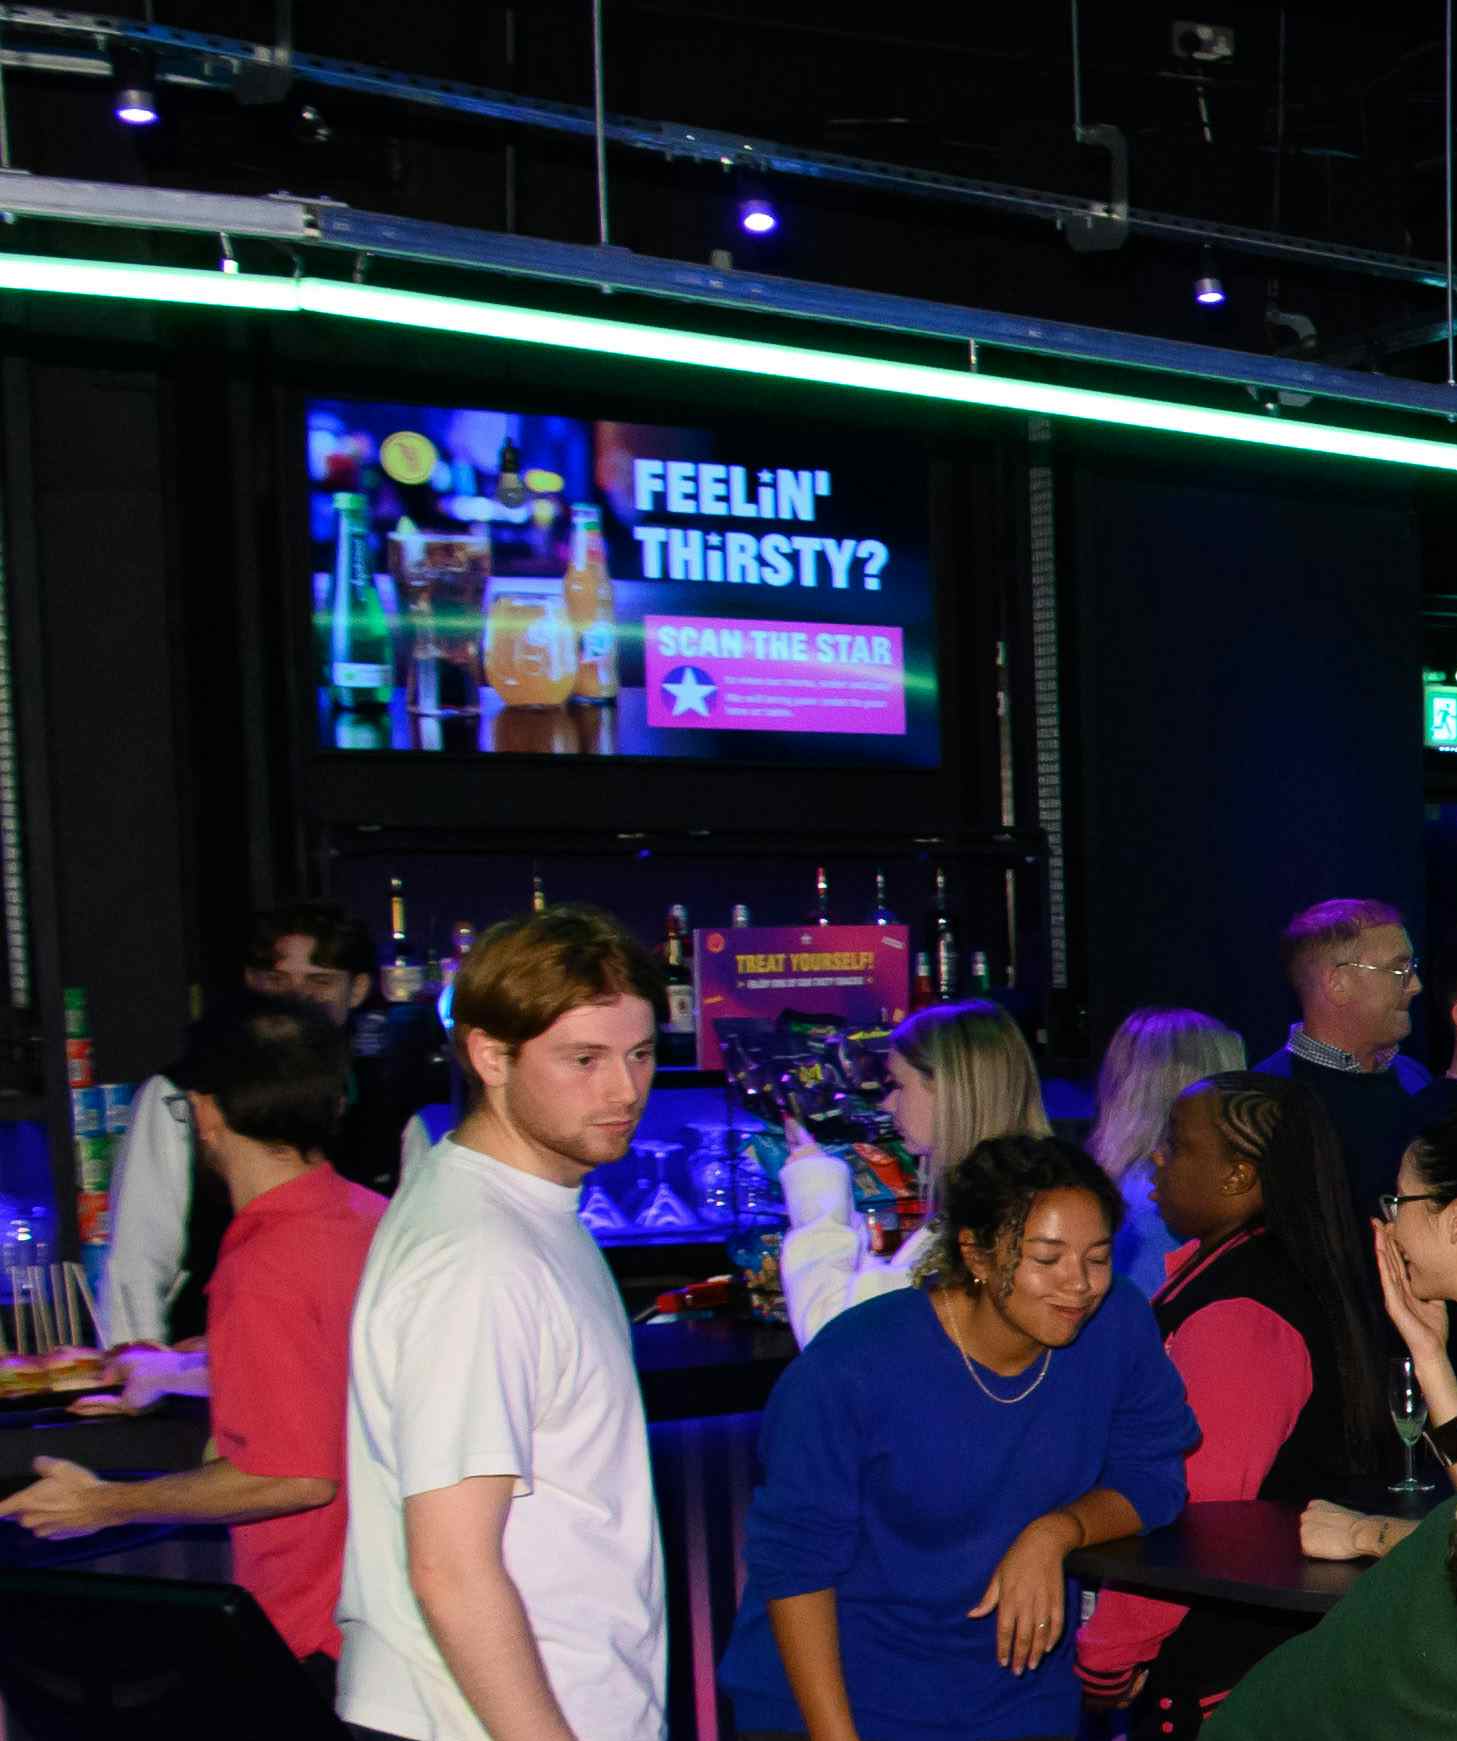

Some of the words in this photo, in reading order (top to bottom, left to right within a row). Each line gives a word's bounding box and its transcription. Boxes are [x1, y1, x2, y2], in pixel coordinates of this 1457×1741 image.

[656, 625, 745, 659] SCAN
[750, 630, 809, 662] THE
[815, 633, 893, 665] STAR
[736, 953, 785, 974] TREAT
